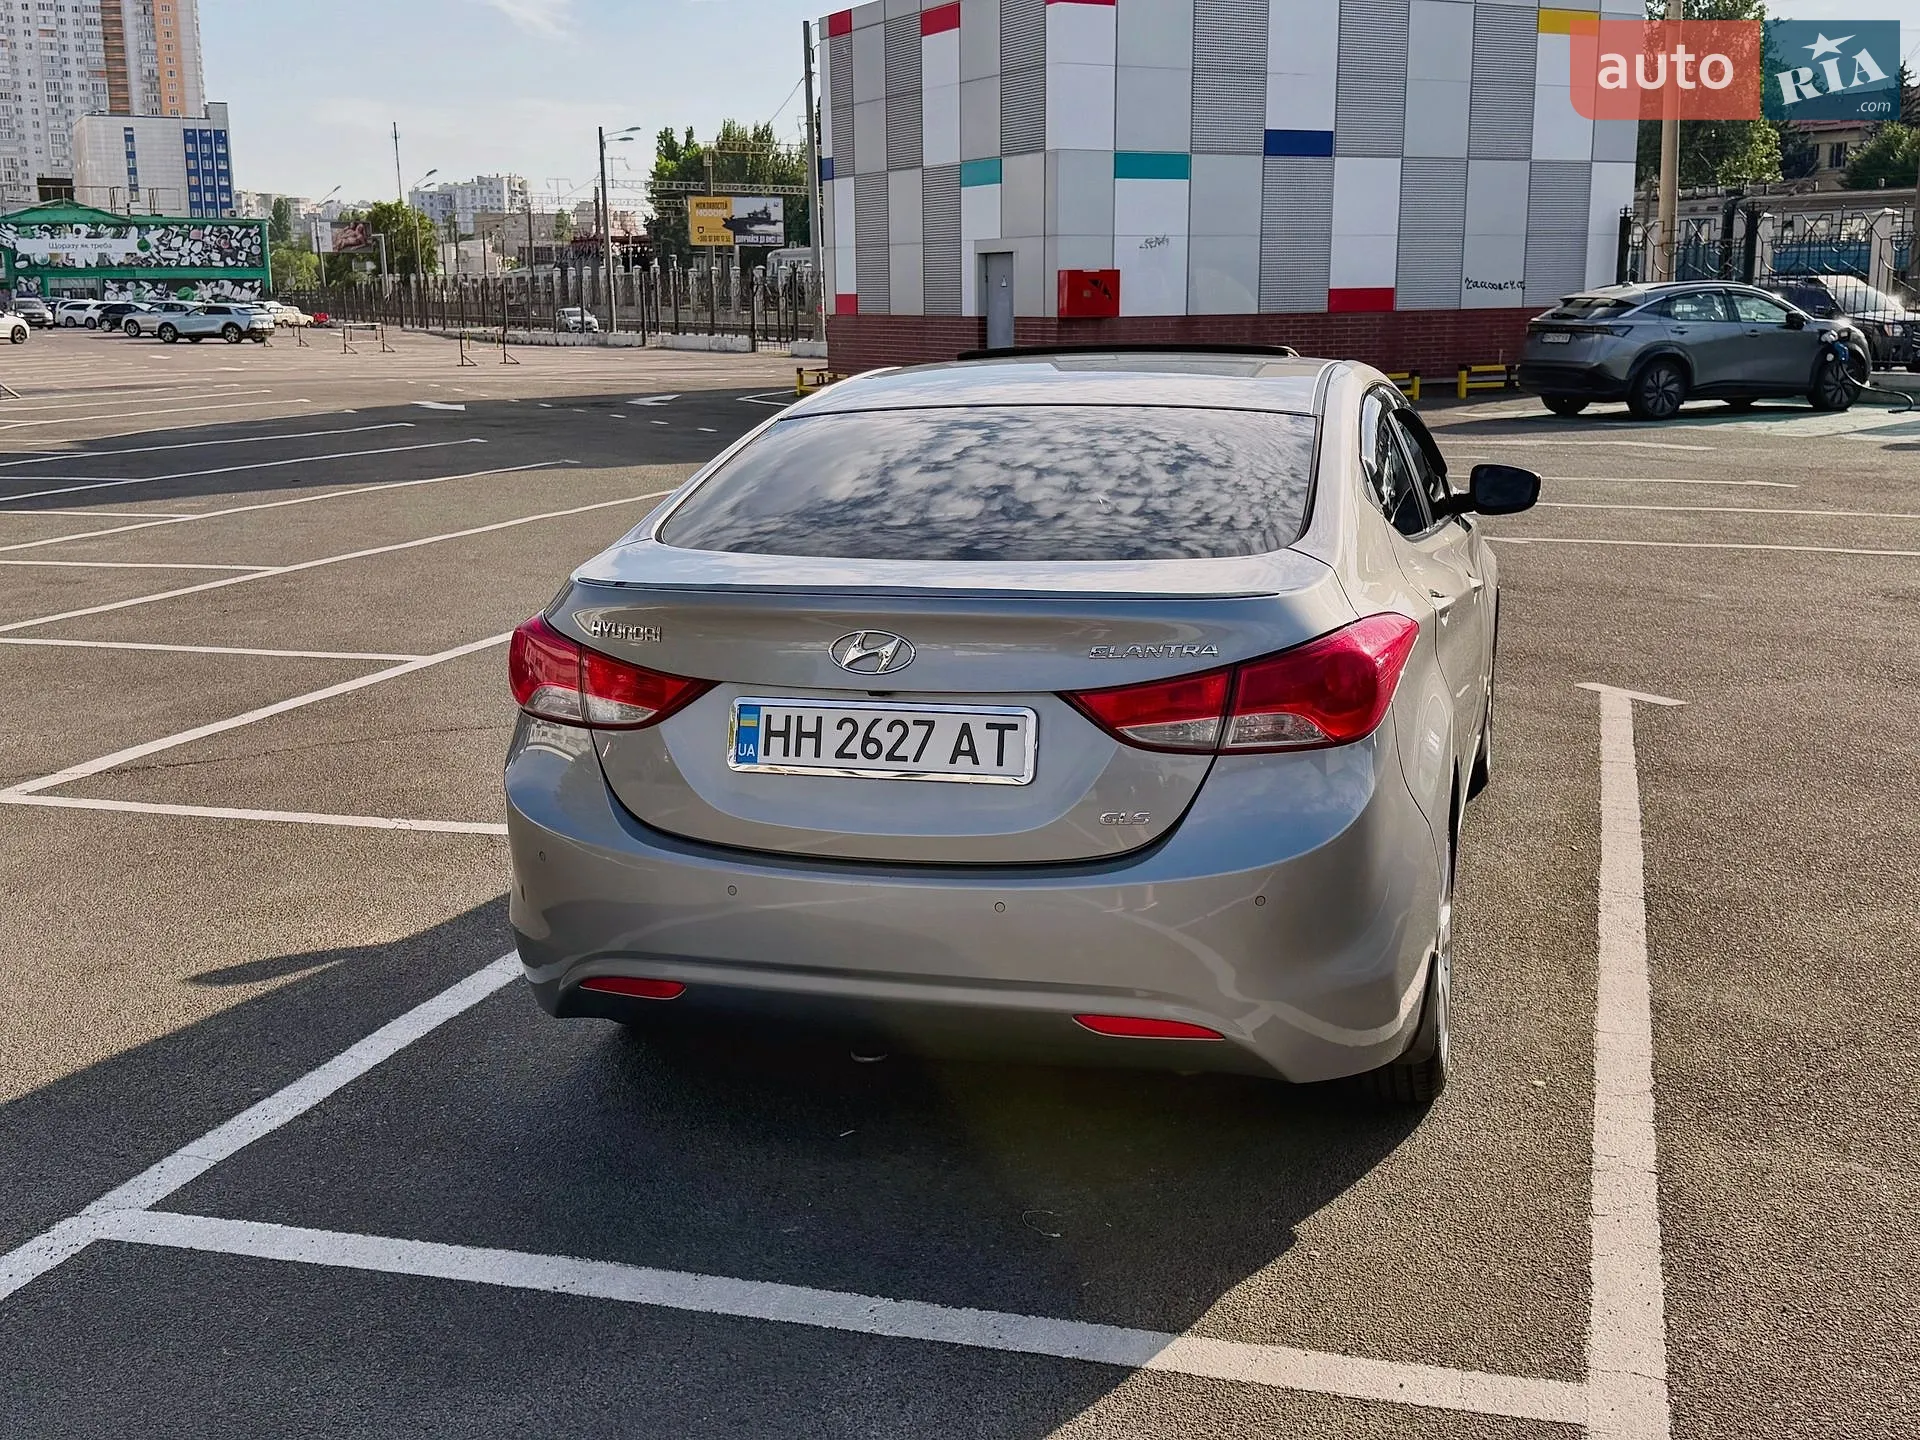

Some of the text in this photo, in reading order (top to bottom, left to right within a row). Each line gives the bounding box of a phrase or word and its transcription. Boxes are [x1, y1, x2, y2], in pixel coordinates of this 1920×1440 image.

[48, 242, 78, 250] Щоразу
[90, 242, 113, 250] треба
[591, 620, 662, 642] HYUNDAI
[1088, 643, 1219, 659] ELANTRA
[763, 714, 1018, 767] HH 2627 AT
[737, 743, 756, 757] UA
[1099, 810, 1151, 826] GLS
